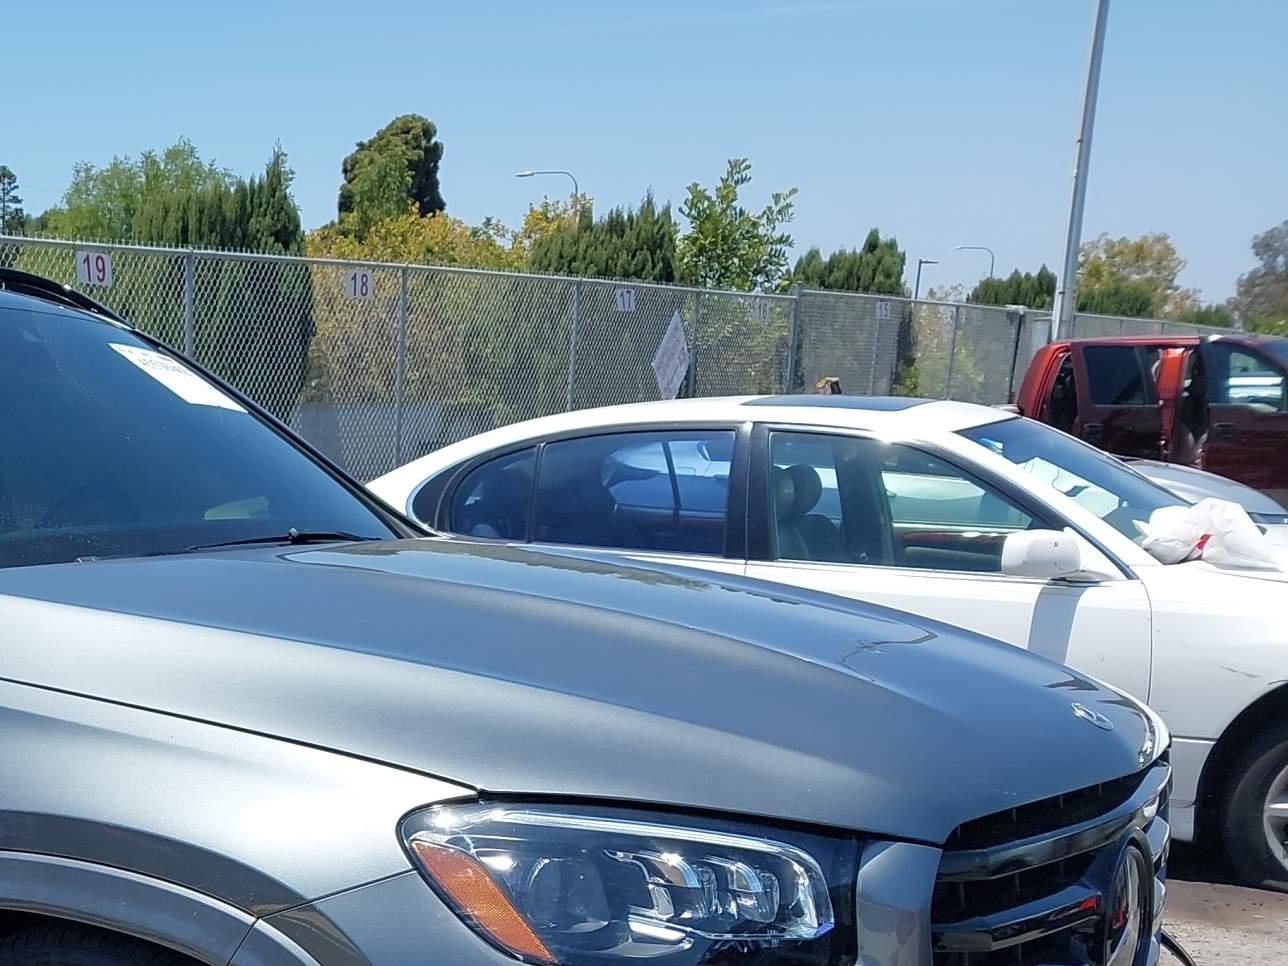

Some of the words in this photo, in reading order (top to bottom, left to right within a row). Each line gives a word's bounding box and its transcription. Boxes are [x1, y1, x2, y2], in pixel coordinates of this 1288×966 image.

[83, 253, 106, 283] 19
[350, 271, 369, 297] 18
[619, 289, 632, 310] 17
